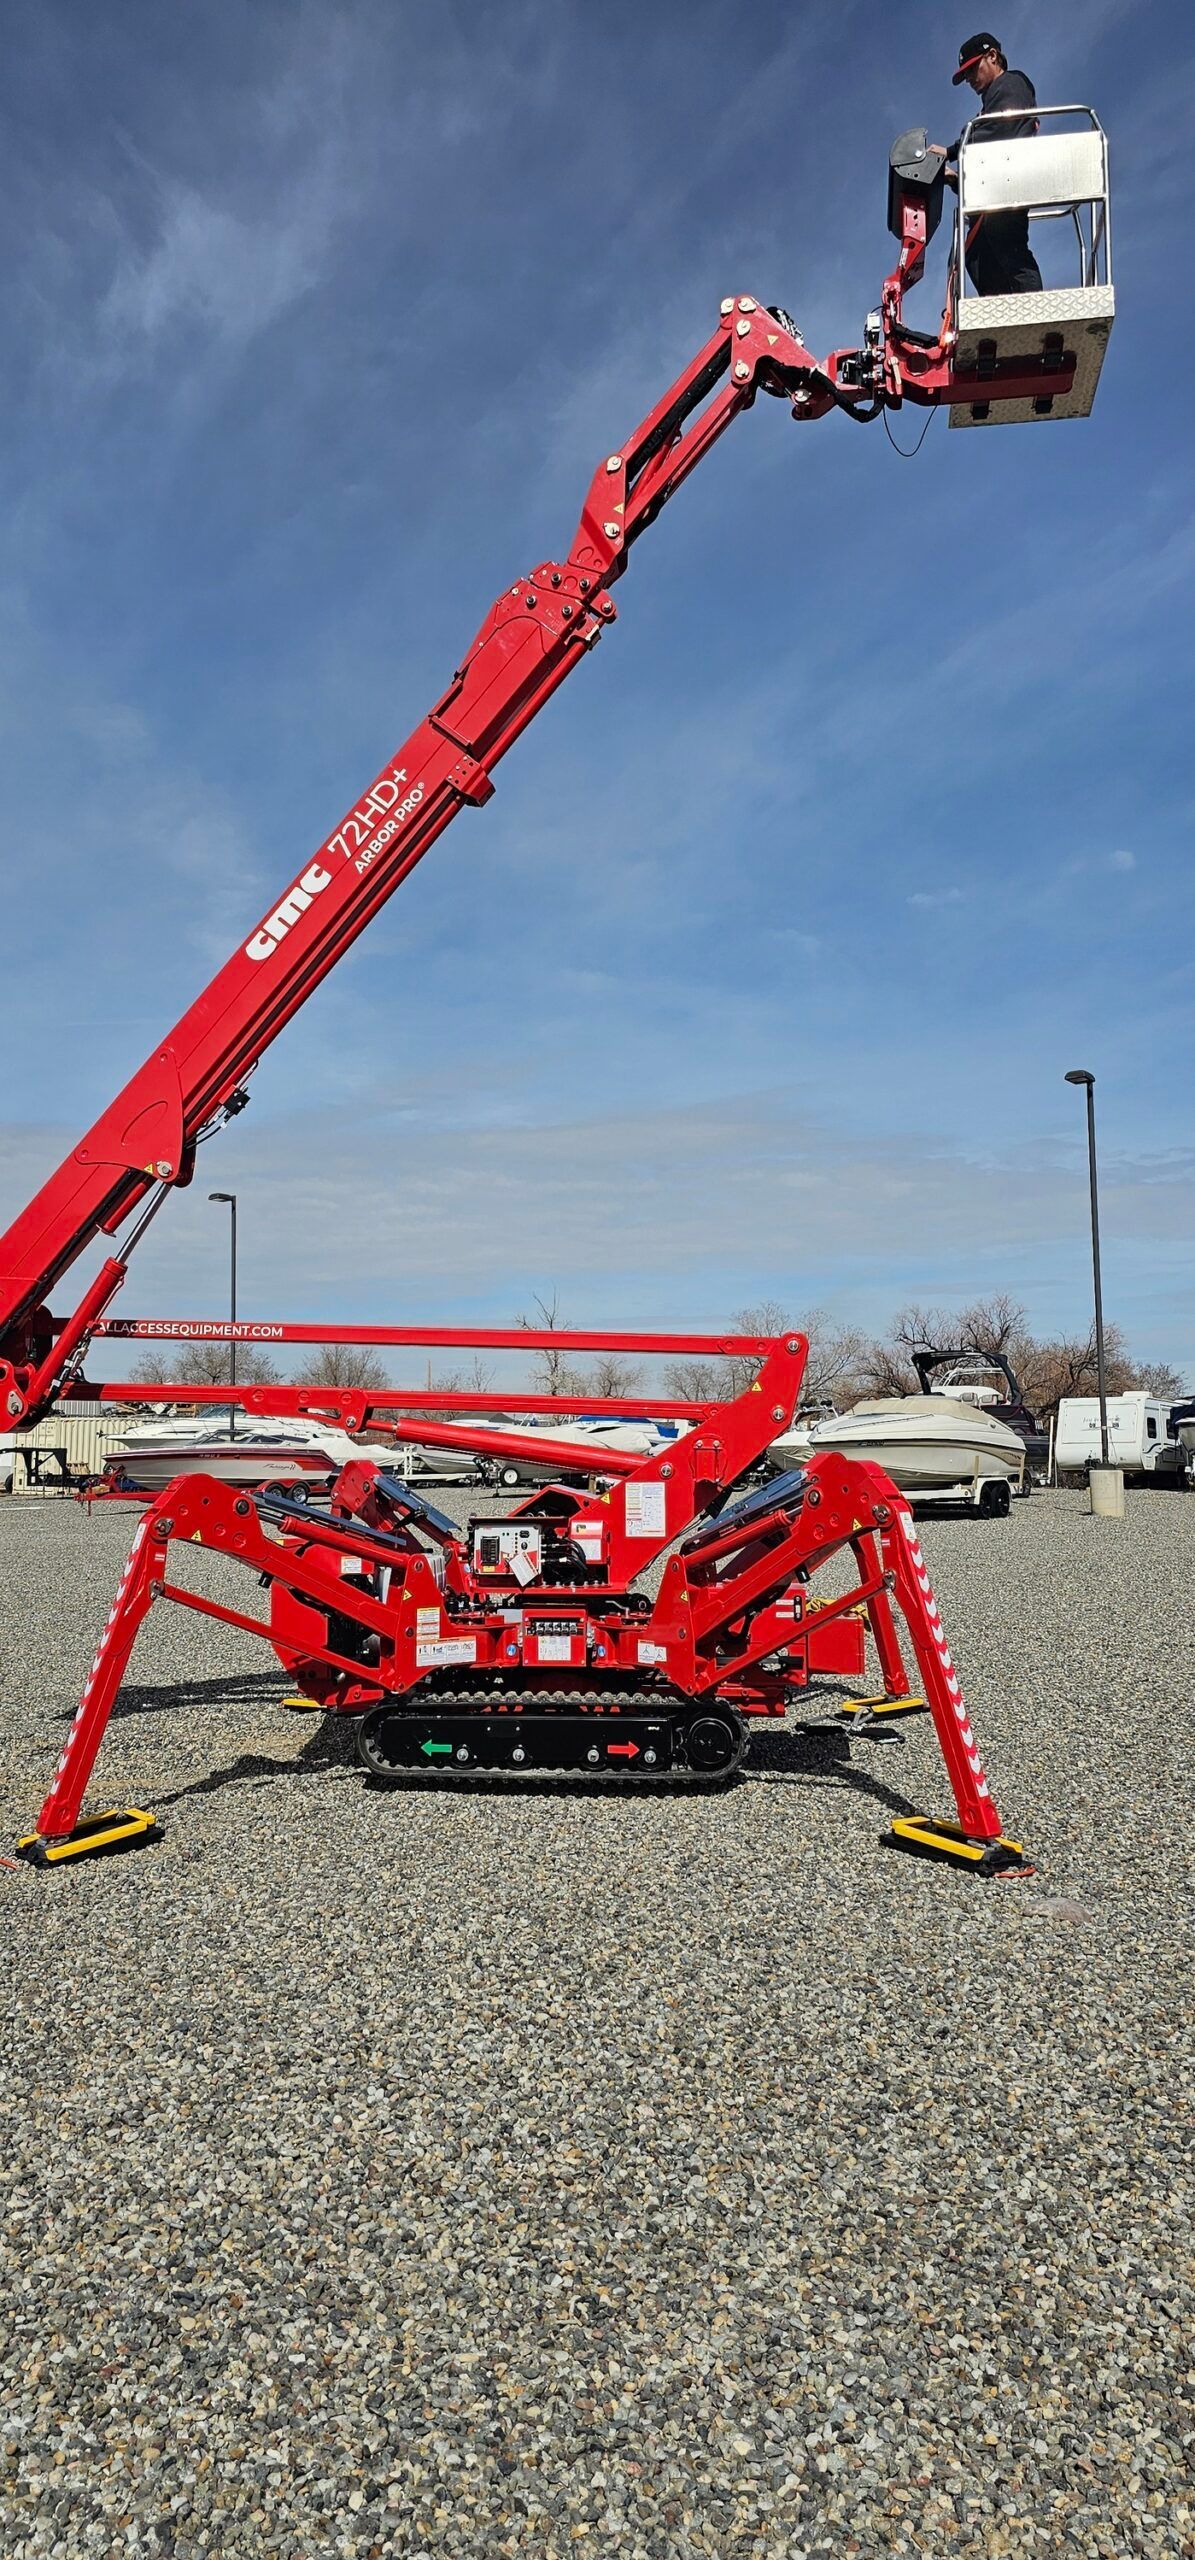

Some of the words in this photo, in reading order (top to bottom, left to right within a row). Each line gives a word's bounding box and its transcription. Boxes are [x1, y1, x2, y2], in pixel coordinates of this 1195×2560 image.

[245, 862, 332, 961] cmc
[326, 768, 407, 859] 72HD+
[354, 820, 400, 875] ARBOR
[98, 1321, 283, 1338] ALLACCESSEQUIPMENT.COM
